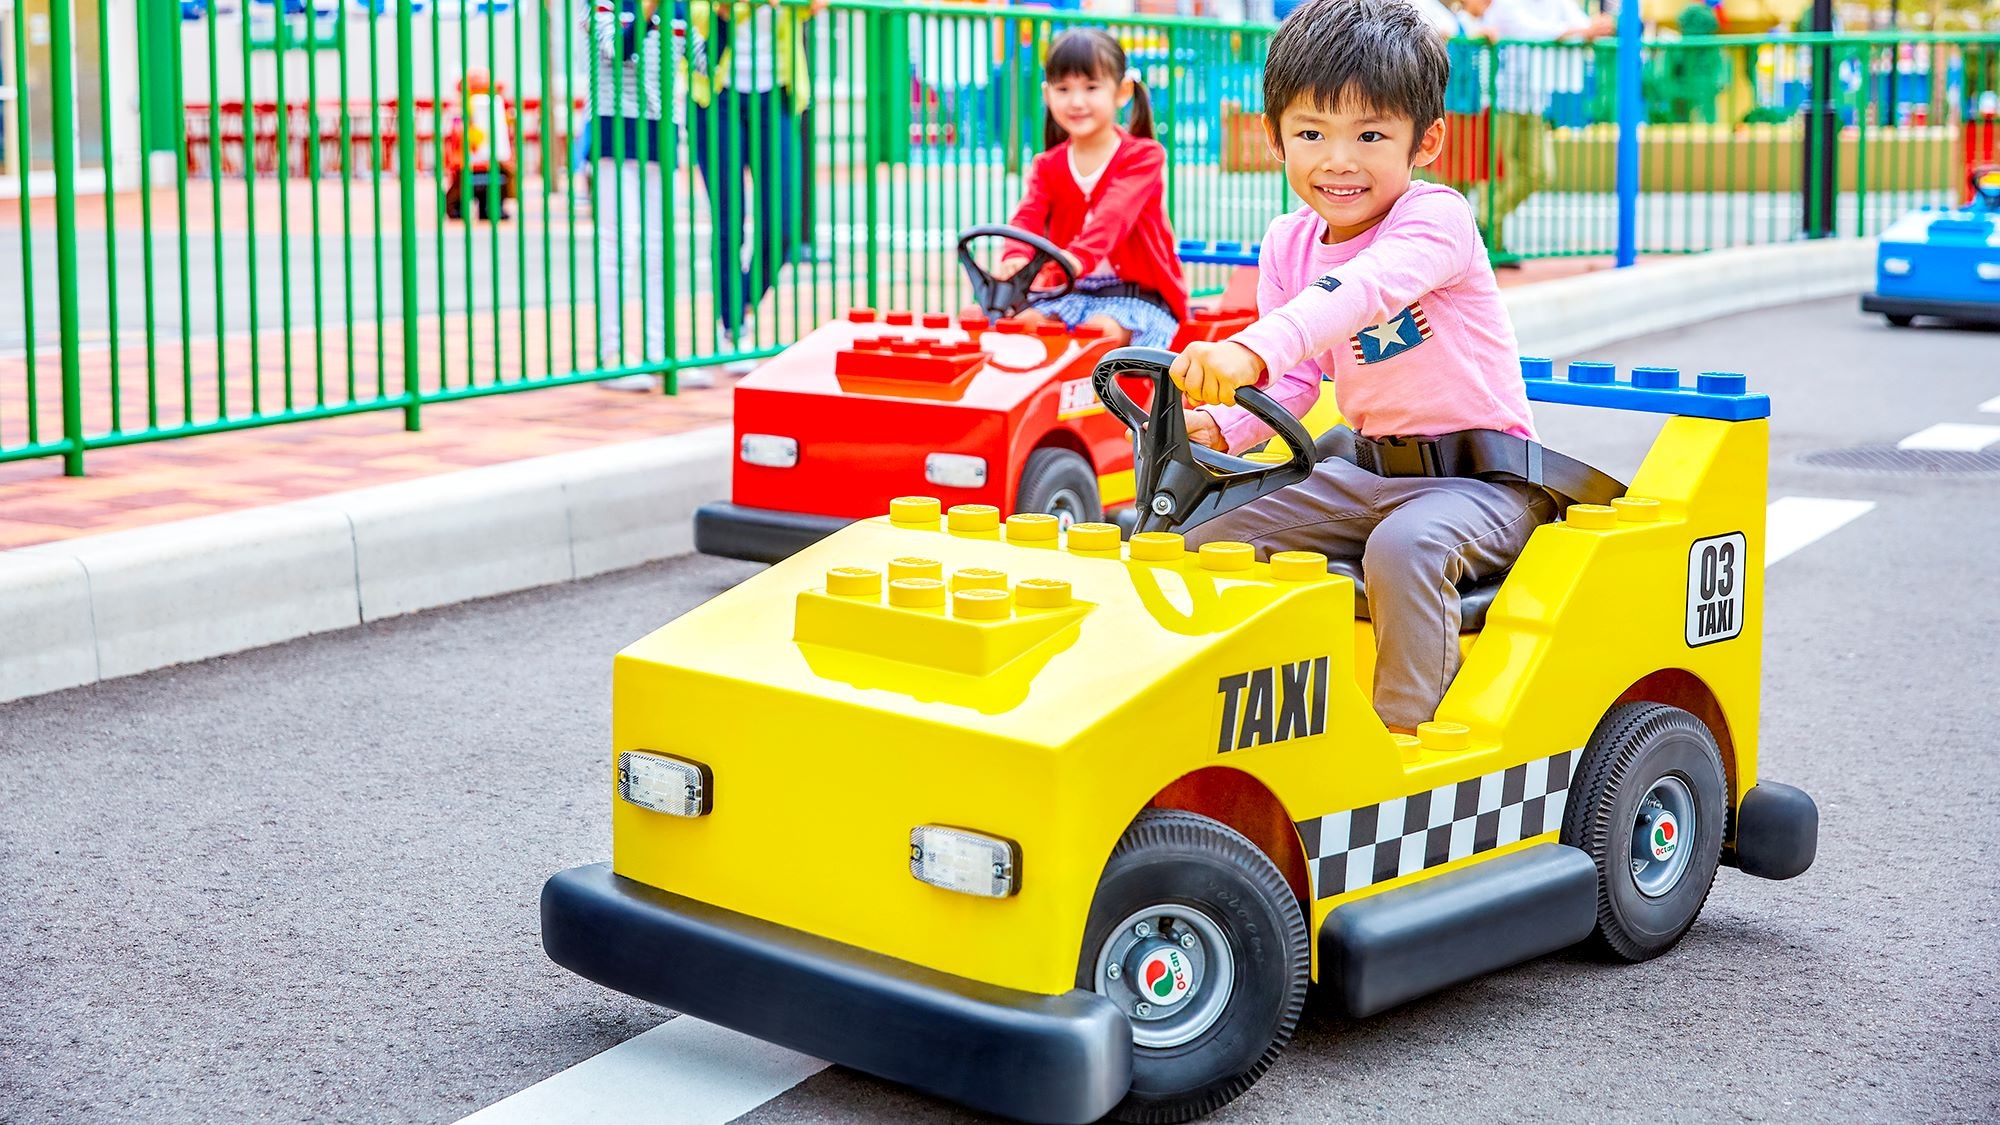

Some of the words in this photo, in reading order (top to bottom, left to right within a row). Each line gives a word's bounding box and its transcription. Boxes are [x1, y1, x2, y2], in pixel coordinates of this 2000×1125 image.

[1700, 542, 1735, 600] 03
[1697, 598, 1734, 637] TAXI
[1217, 656, 1330, 754] TAXI
